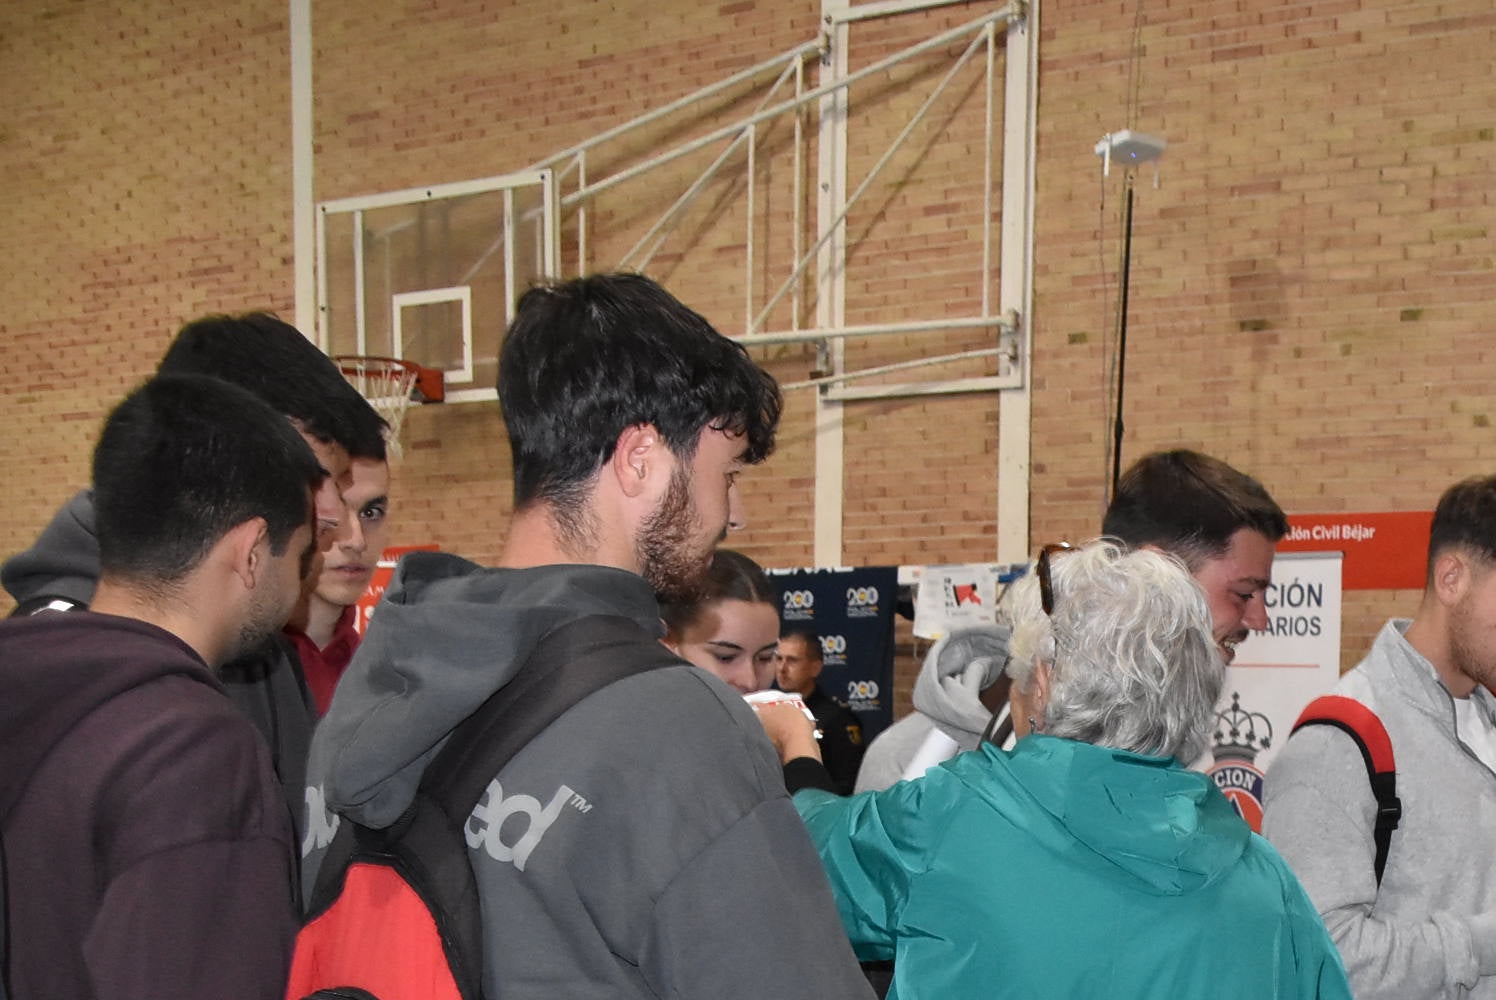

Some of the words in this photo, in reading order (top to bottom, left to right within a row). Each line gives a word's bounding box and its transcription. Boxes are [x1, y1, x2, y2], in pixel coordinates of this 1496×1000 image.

[1312, 524, 1341, 540] Civil
[1342, 523, 1376, 542] Béjar
[1263, 577, 1323, 607] CIÓN
[1261, 616, 1321, 637] ARIOS
[1214, 768, 1256, 791] CION
